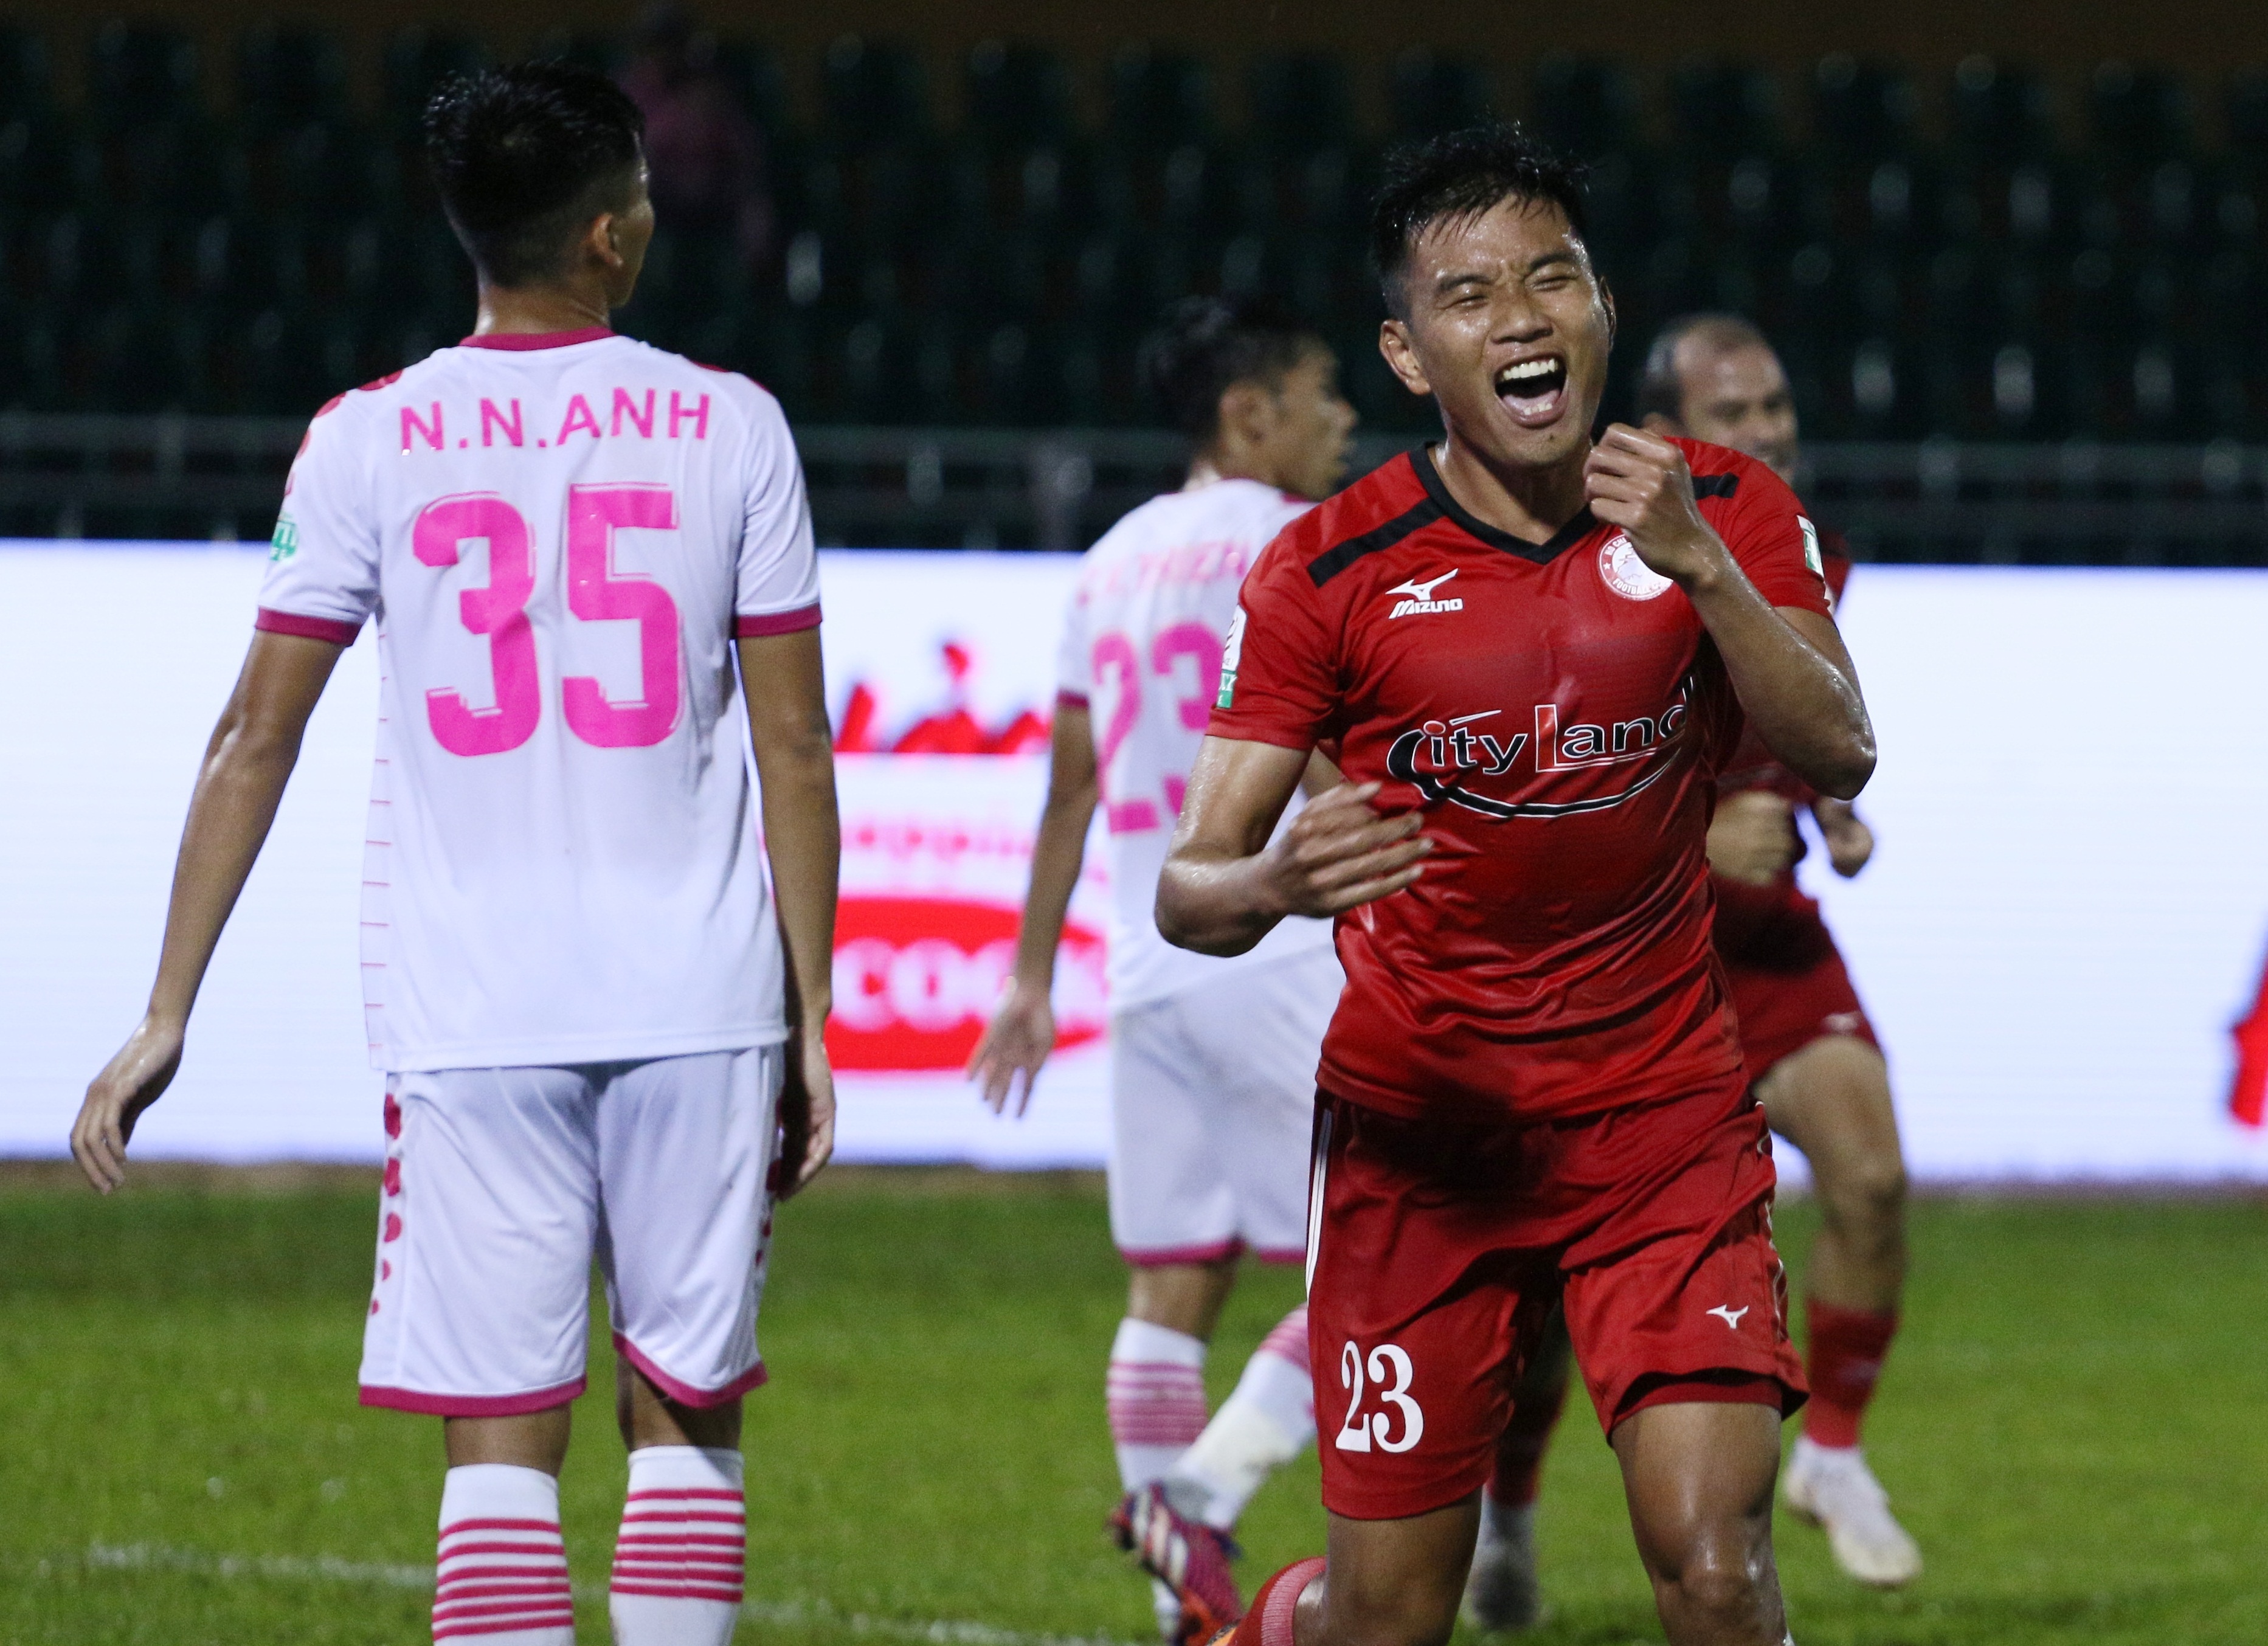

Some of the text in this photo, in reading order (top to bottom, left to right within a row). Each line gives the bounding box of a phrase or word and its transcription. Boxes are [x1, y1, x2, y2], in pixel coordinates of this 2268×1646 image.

[400, 387, 711, 456] N.N.ANH
[412, 482, 685, 756] 35
[1388, 598, 1464, 620] MIZUNO
[1613, 578, 1651, 595] FOOTBALL
[1093, 621, 1224, 834] 23
[1335, 1340, 1424, 1453] 23
